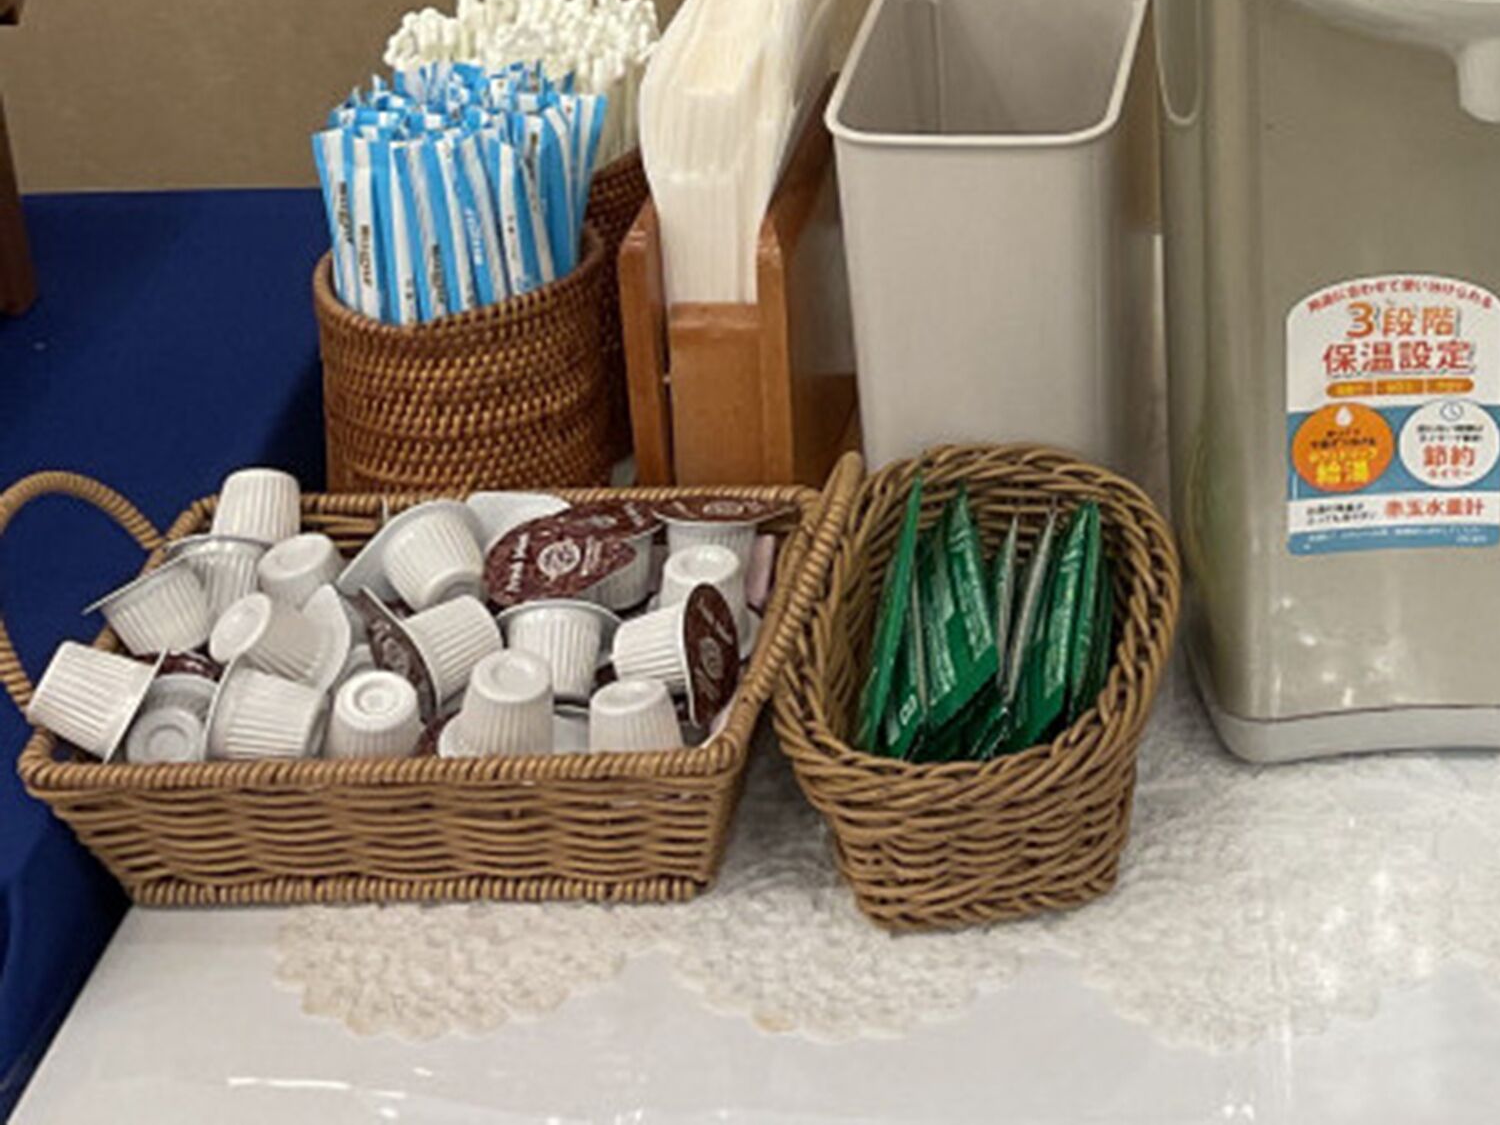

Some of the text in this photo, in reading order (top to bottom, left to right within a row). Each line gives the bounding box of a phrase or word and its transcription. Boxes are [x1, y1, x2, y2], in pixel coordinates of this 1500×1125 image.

[1345, 301, 1455, 339] 3段階
[1322, 340, 1472, 374] 保温設定
